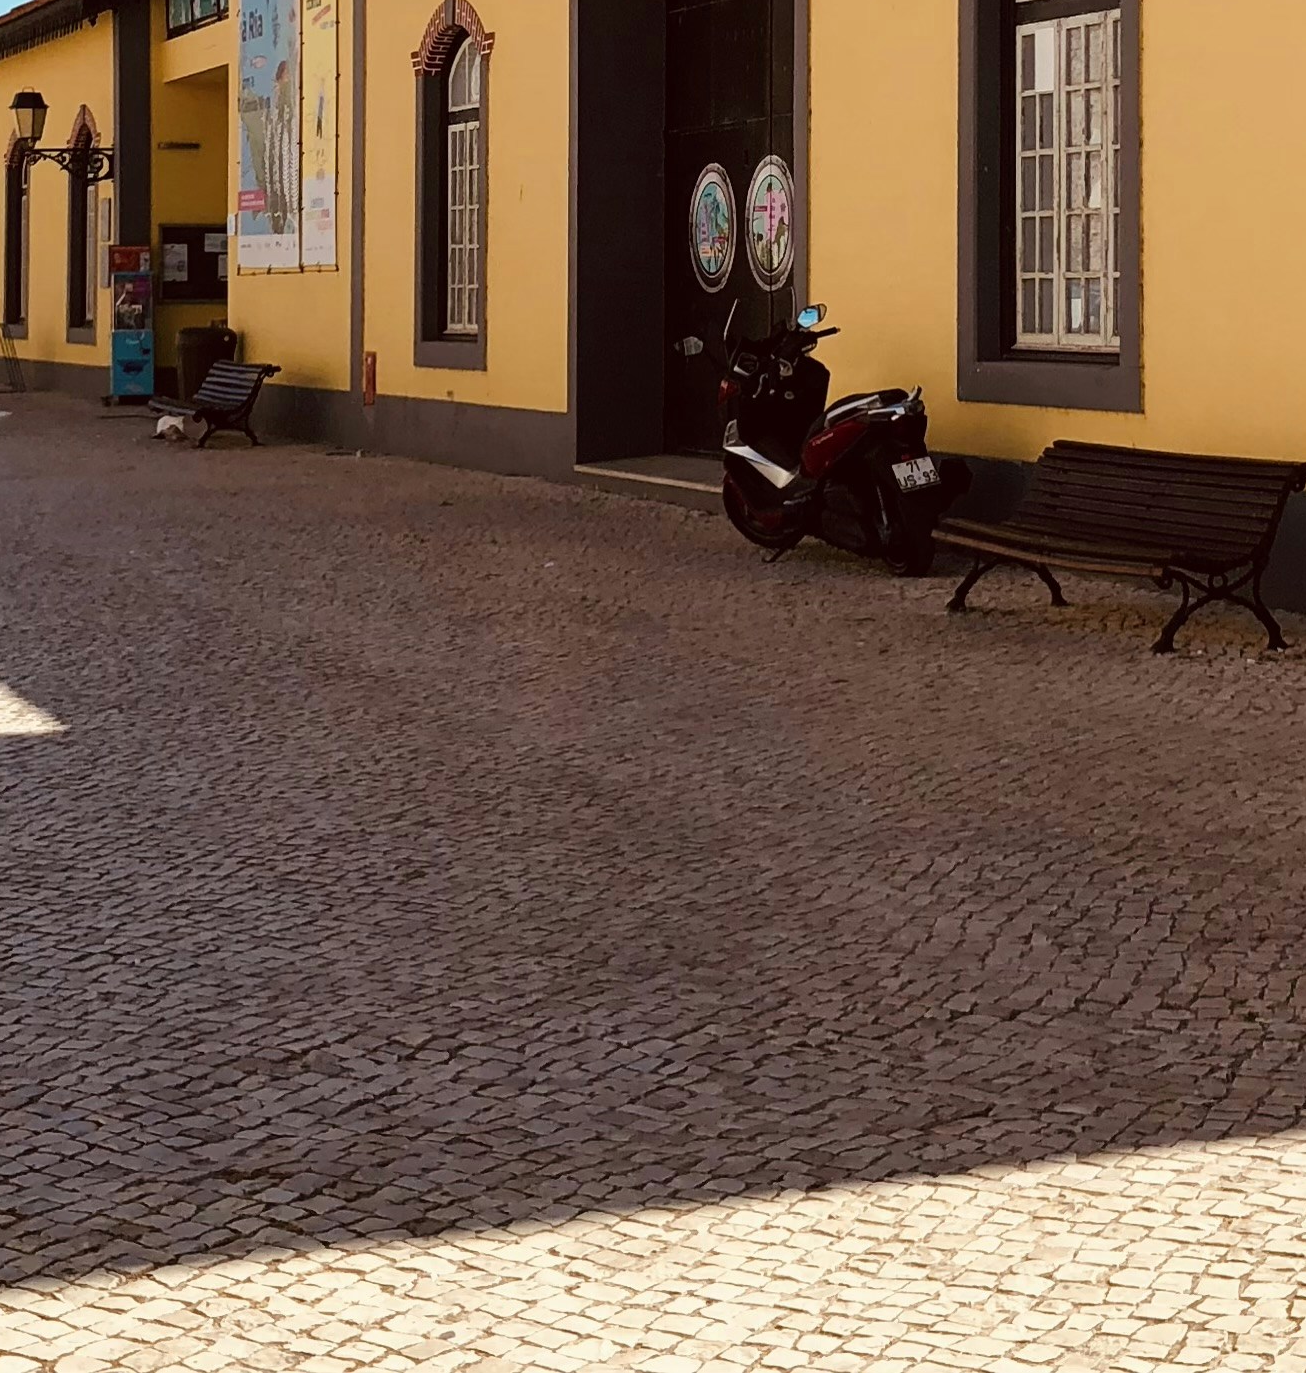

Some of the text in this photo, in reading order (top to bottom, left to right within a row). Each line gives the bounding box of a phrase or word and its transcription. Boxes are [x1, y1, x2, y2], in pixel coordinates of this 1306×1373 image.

[249, 9, 263, 40] Ria
[906, 460, 921, 473] 71
[923, 469, 939, 482] 93
